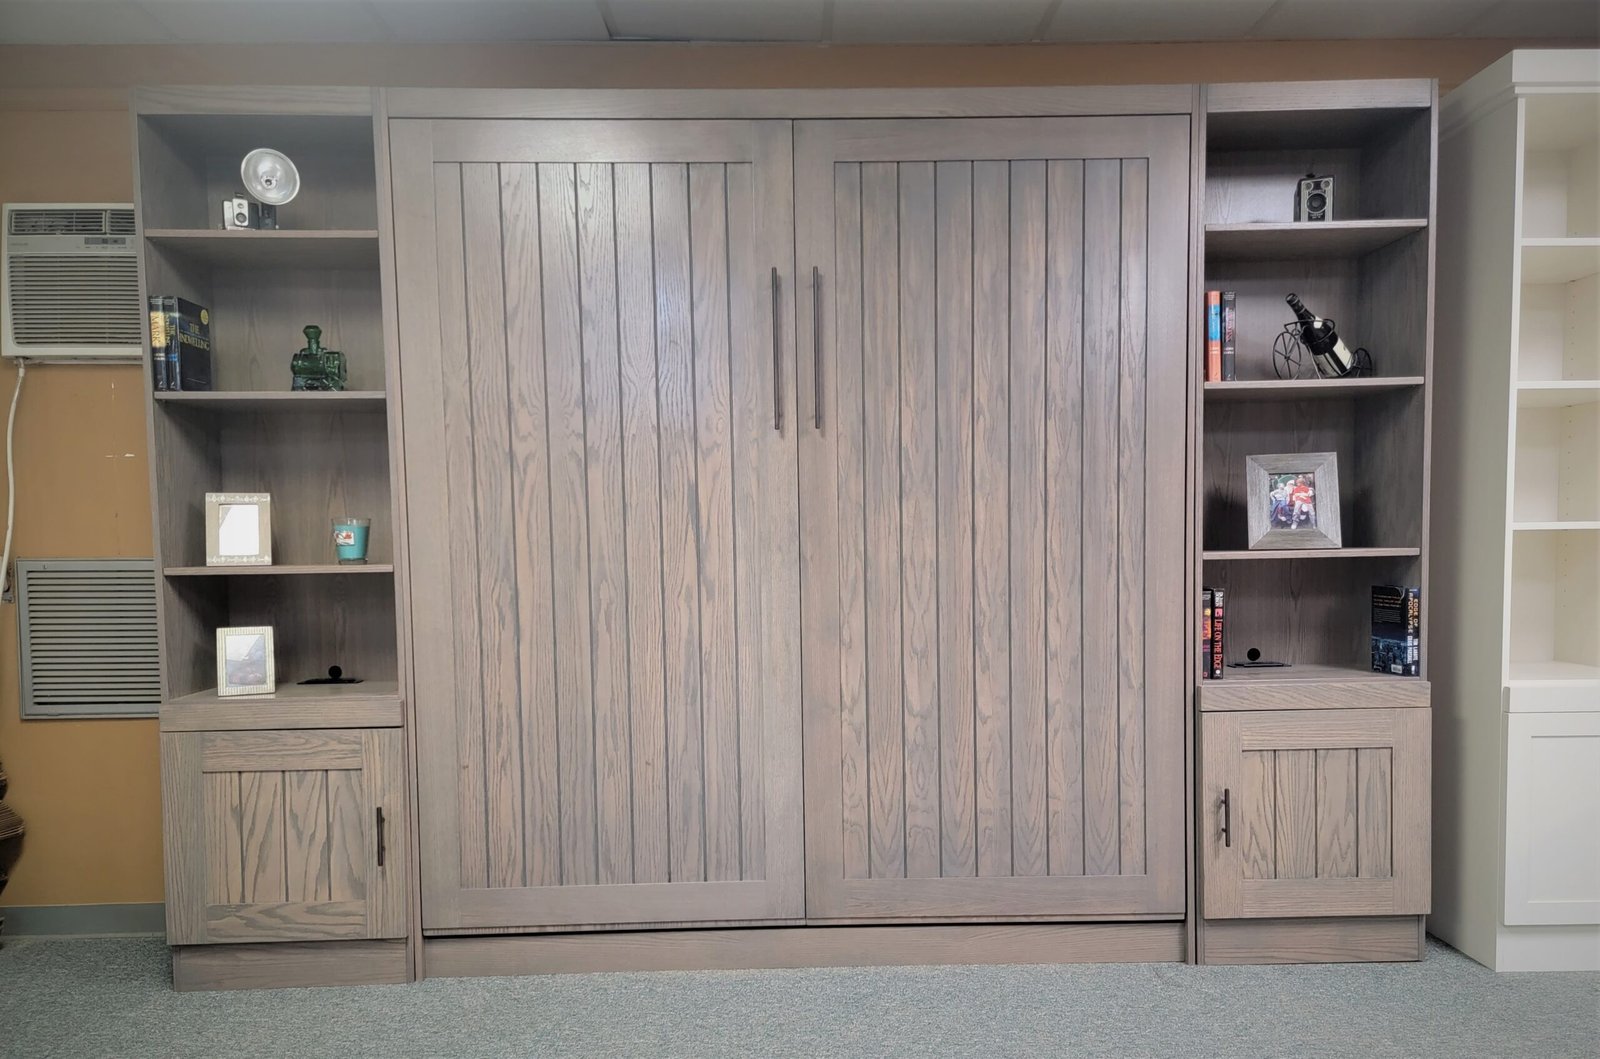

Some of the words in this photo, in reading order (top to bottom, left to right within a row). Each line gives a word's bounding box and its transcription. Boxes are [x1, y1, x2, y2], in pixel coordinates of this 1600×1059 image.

[151, 315, 161, 343] MARK
[1214, 619, 1222, 631] LIFE
[1413, 618, 1419, 628] OF
[1214, 631, 1222, 641] ON
[1214, 642, 1222, 653] THE
[1214, 654, 1222, 669] EDGE
